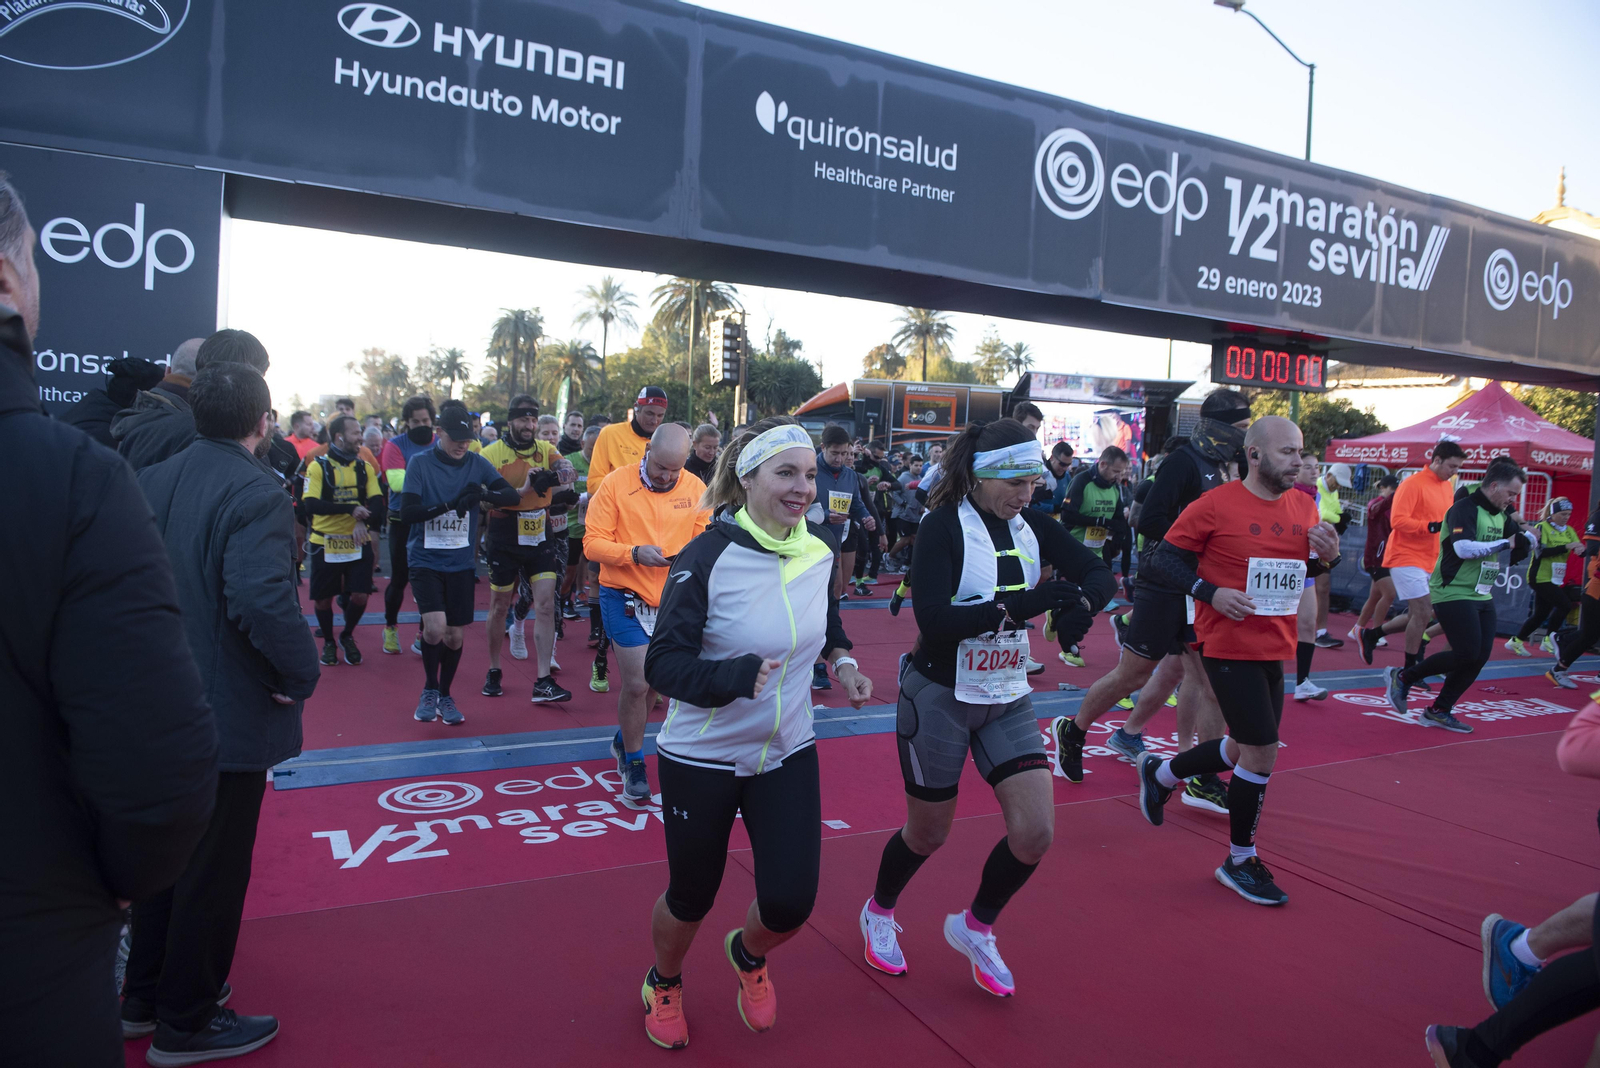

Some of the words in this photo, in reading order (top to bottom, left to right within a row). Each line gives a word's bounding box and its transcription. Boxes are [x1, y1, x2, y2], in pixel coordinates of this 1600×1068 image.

[433, 22, 625, 90] HYUNDAI
[334, 57, 523, 117] Hyundauto
[531, 95, 622, 135] Motor
[786, 116, 958, 171] quirónsalud
[814, 161, 898, 192] Healthcare
[901, 177, 955, 203] Partner
[1110, 151, 1208, 237] edp
[1270, 186, 1418, 252] maratón
[40, 202, 195, 291] edp
[1308, 237, 1419, 289] sevilla
[1197, 266, 1221, 291] 29
[1225, 274, 1278, 300] enero
[1281, 280, 1322, 308] 2023
[1521, 261, 1573, 320] edp
[429, 519, 463, 531] 11447
[1254, 571, 1297, 590] 11146
[1494, 566, 1523, 594] dp
[964, 648, 1020, 671] 12024
